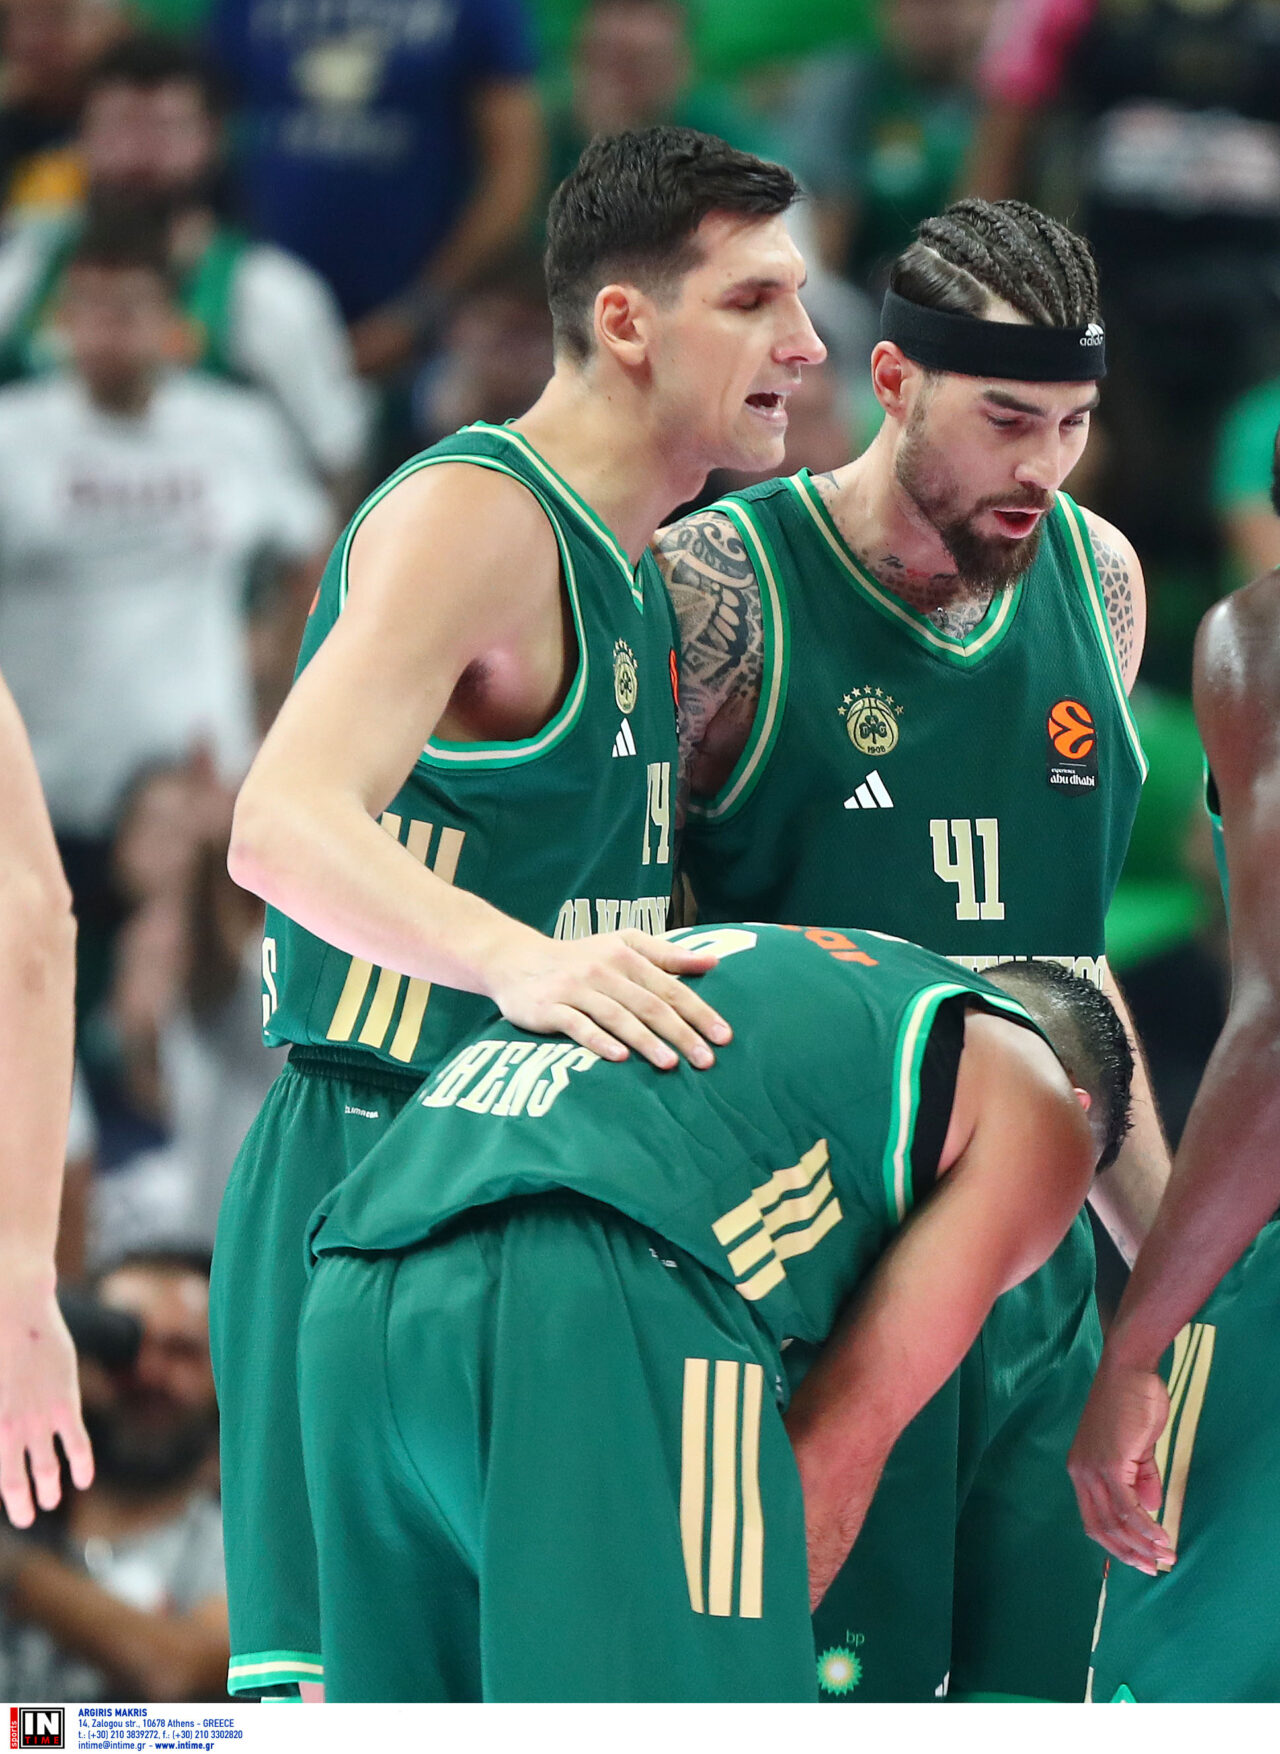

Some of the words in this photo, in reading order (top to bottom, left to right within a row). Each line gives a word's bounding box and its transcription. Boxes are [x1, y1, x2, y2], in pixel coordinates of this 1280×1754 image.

[1050, 774, 1069, 785] abu
[1070, 775, 1095, 787] dhabi
[929, 817, 1005, 921] 41
[846, 1629, 866, 1647] bp
